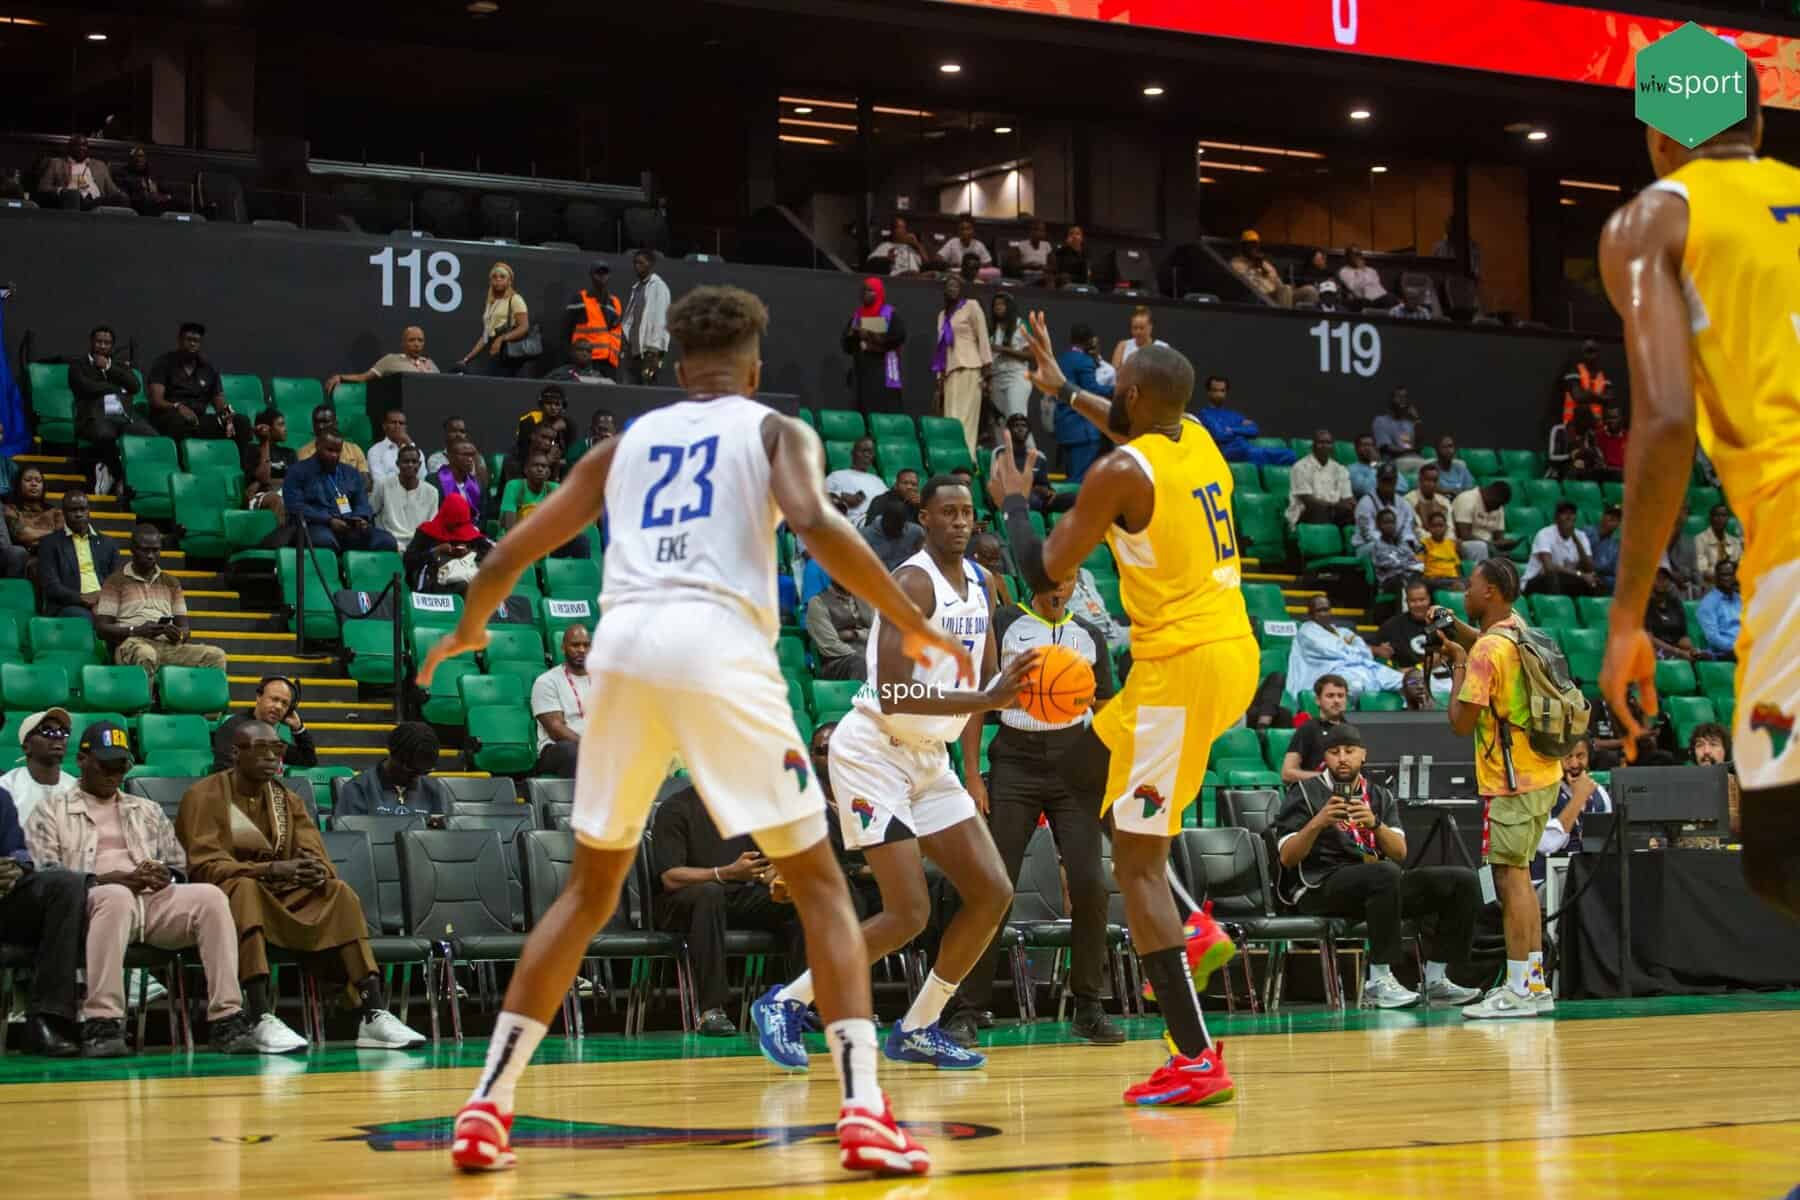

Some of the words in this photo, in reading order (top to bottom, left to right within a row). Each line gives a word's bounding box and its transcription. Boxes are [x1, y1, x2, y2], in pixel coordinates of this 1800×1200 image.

[369, 247, 462, 312] 118
[1310, 320, 1380, 377] 119
[641, 435, 720, 529] 23
[656, 532, 690, 562] EKE
[1192, 482, 1235, 562] 15
